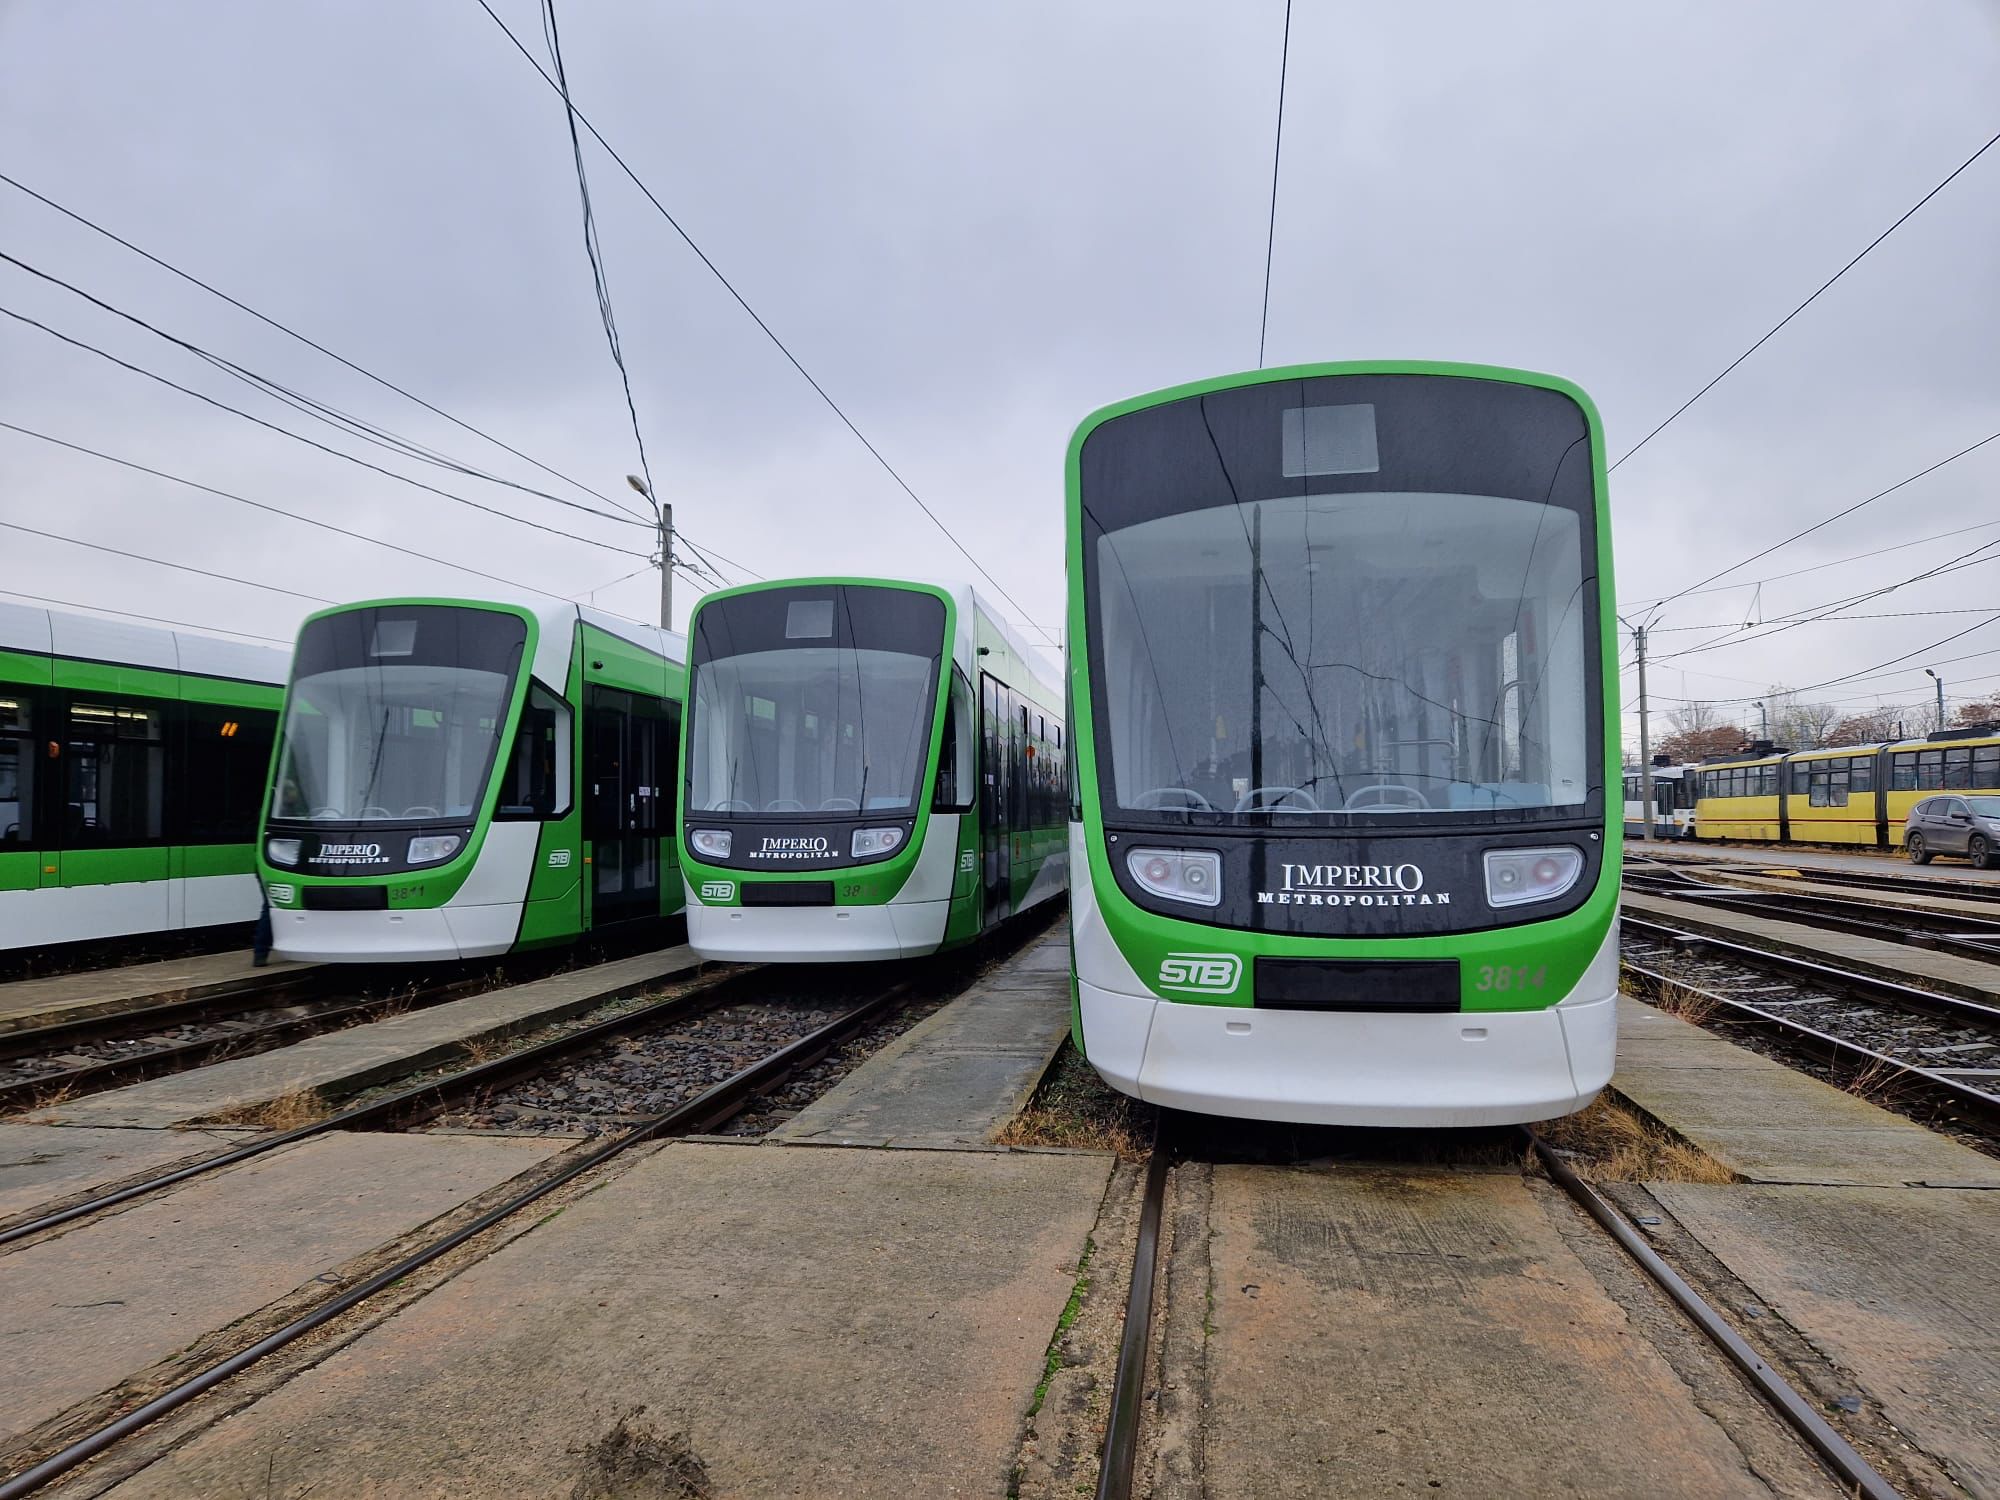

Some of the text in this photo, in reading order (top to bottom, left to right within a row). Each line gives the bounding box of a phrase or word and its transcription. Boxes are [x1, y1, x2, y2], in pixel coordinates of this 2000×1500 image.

[319, 843, 380, 857] IMPERIO
[761, 837, 828, 851] IMPERIO
[308, 856, 391, 864] METROPOLITAN
[749, 851, 839, 859] METROPOLITAN
[1281, 863, 1424, 892] IMPERIO
[1257, 892, 1450, 906] METROPOLITAN
[1158, 958, 1235, 986] STB
[1475, 964, 1548, 992] 3814
